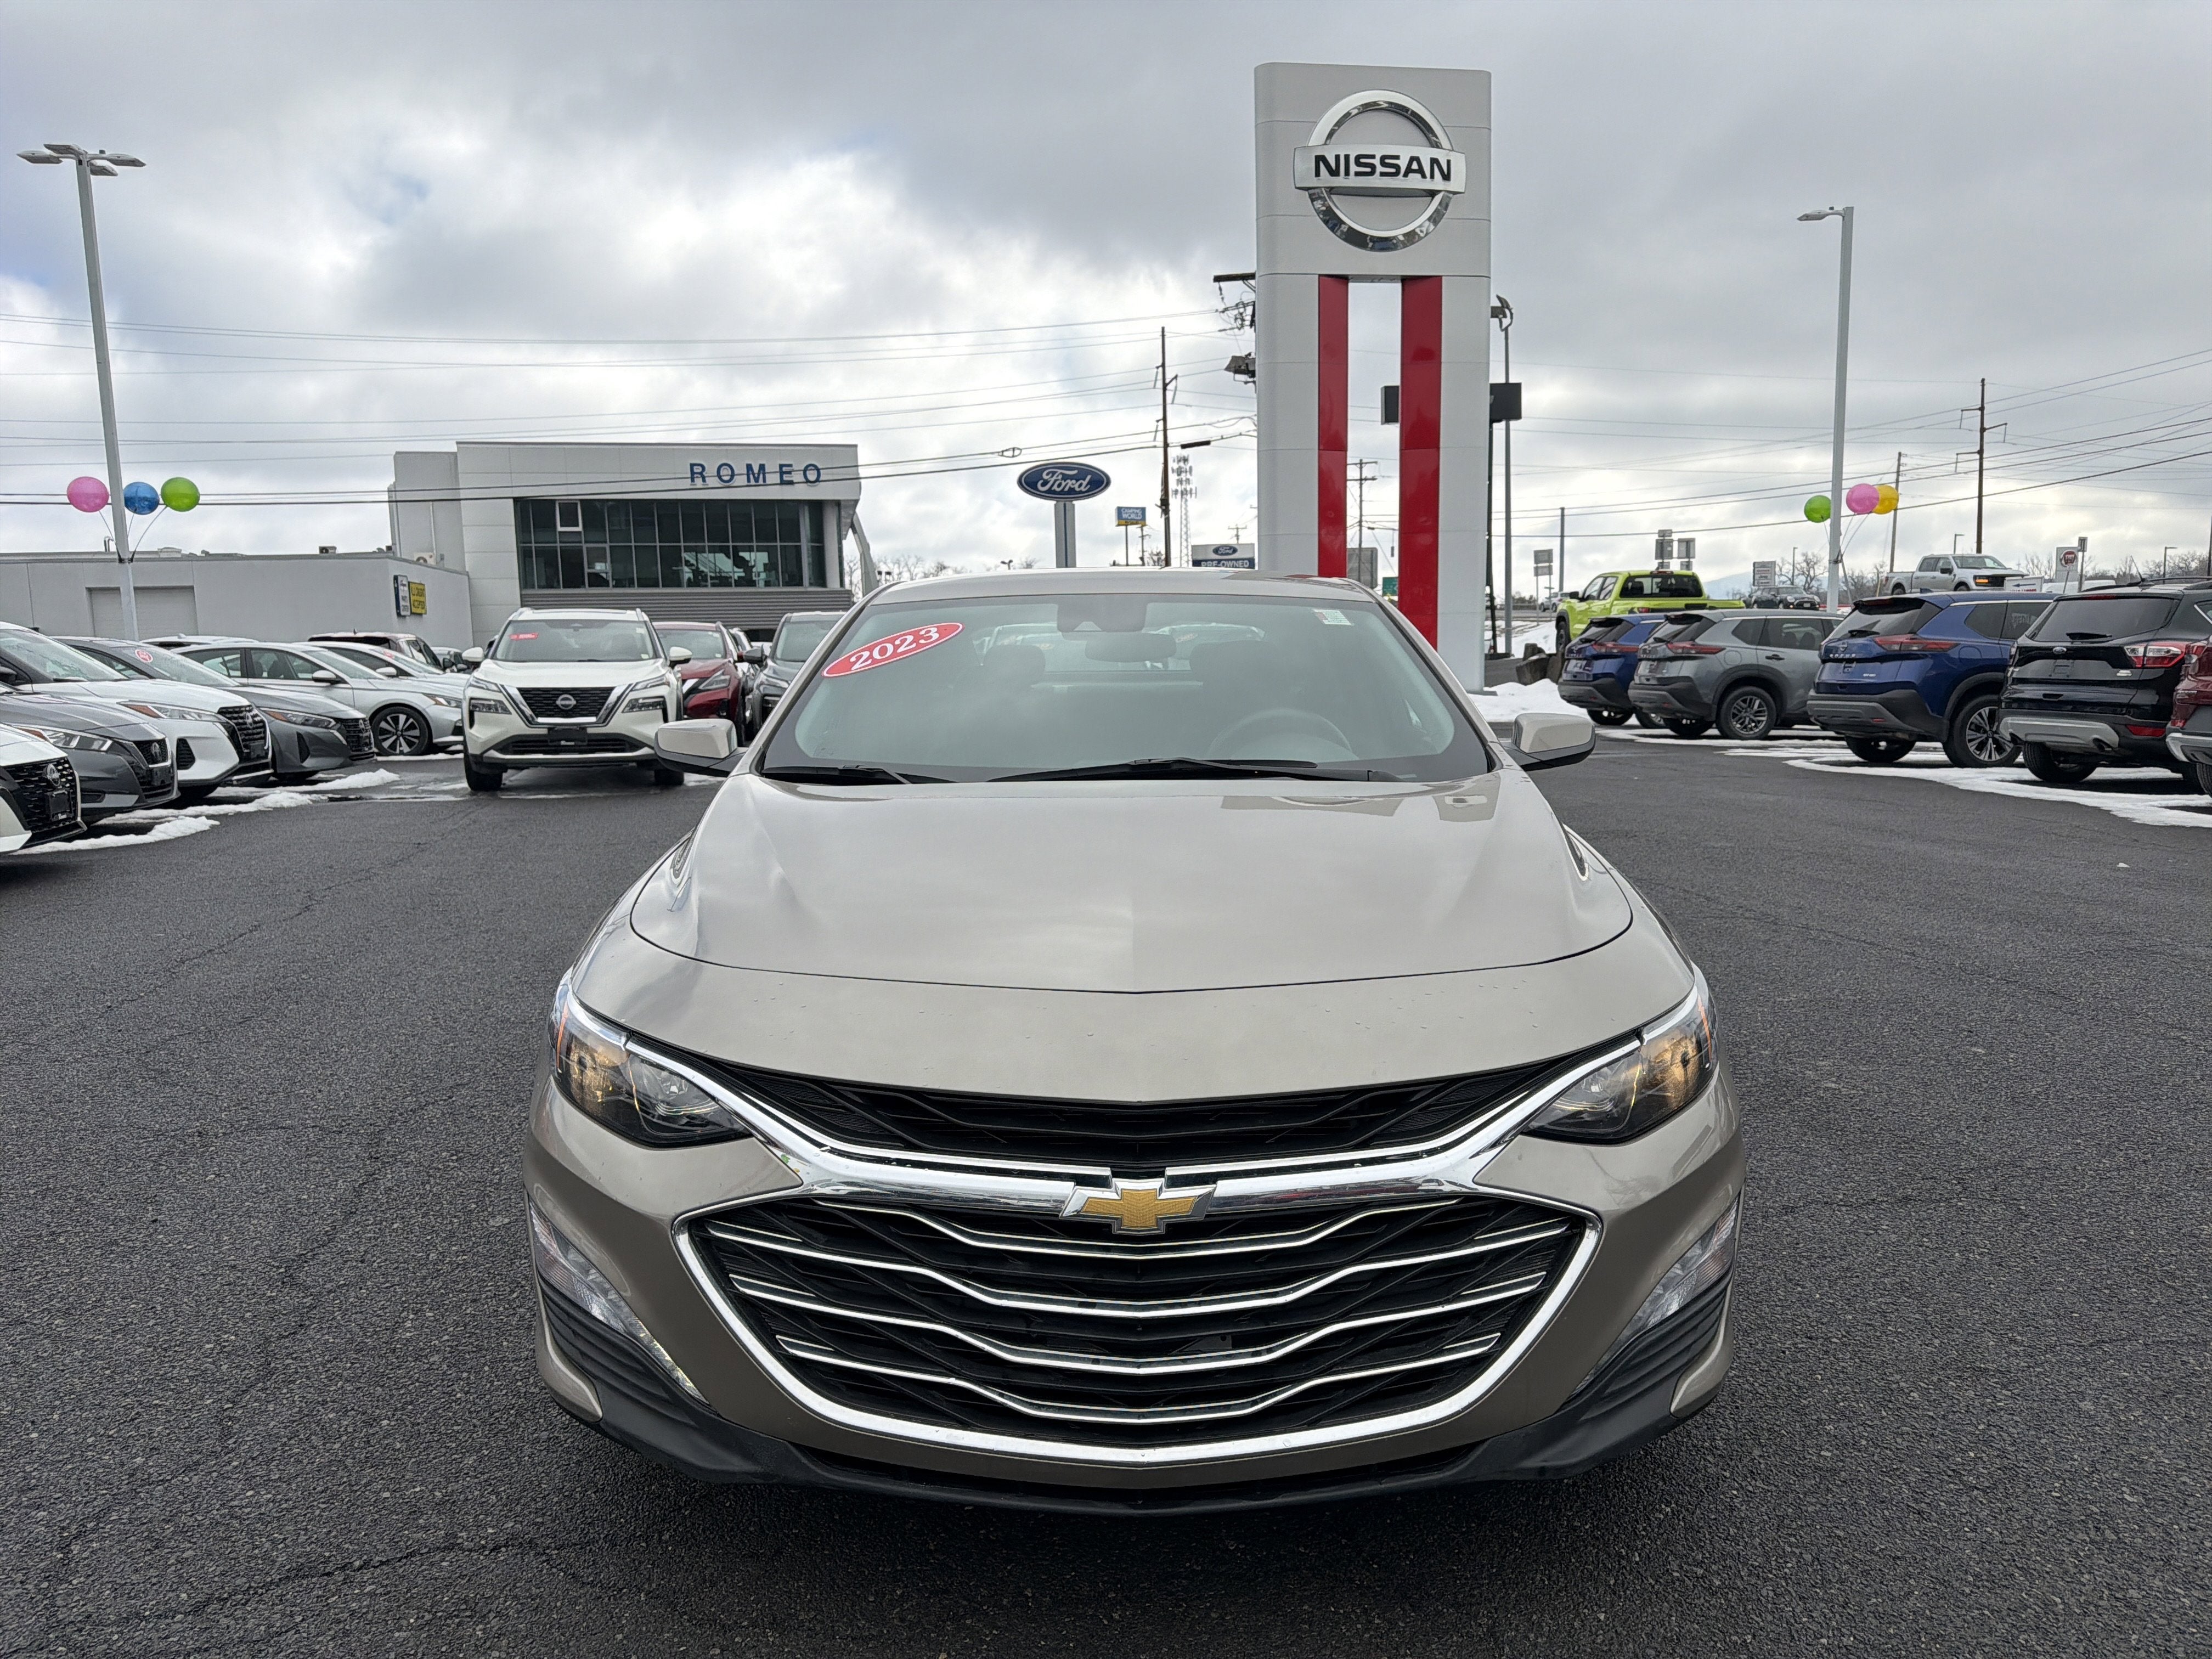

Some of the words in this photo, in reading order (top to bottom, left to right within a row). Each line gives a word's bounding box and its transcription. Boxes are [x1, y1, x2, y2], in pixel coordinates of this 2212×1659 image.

[1314, 154, 1451, 182] NISSAN
[689, 462, 821, 485] ROMEO
[1037, 469, 1092, 492] Ford
[1201, 560, 1250, 568] PRE-OWNED
[850, 627, 940, 670] 2023
